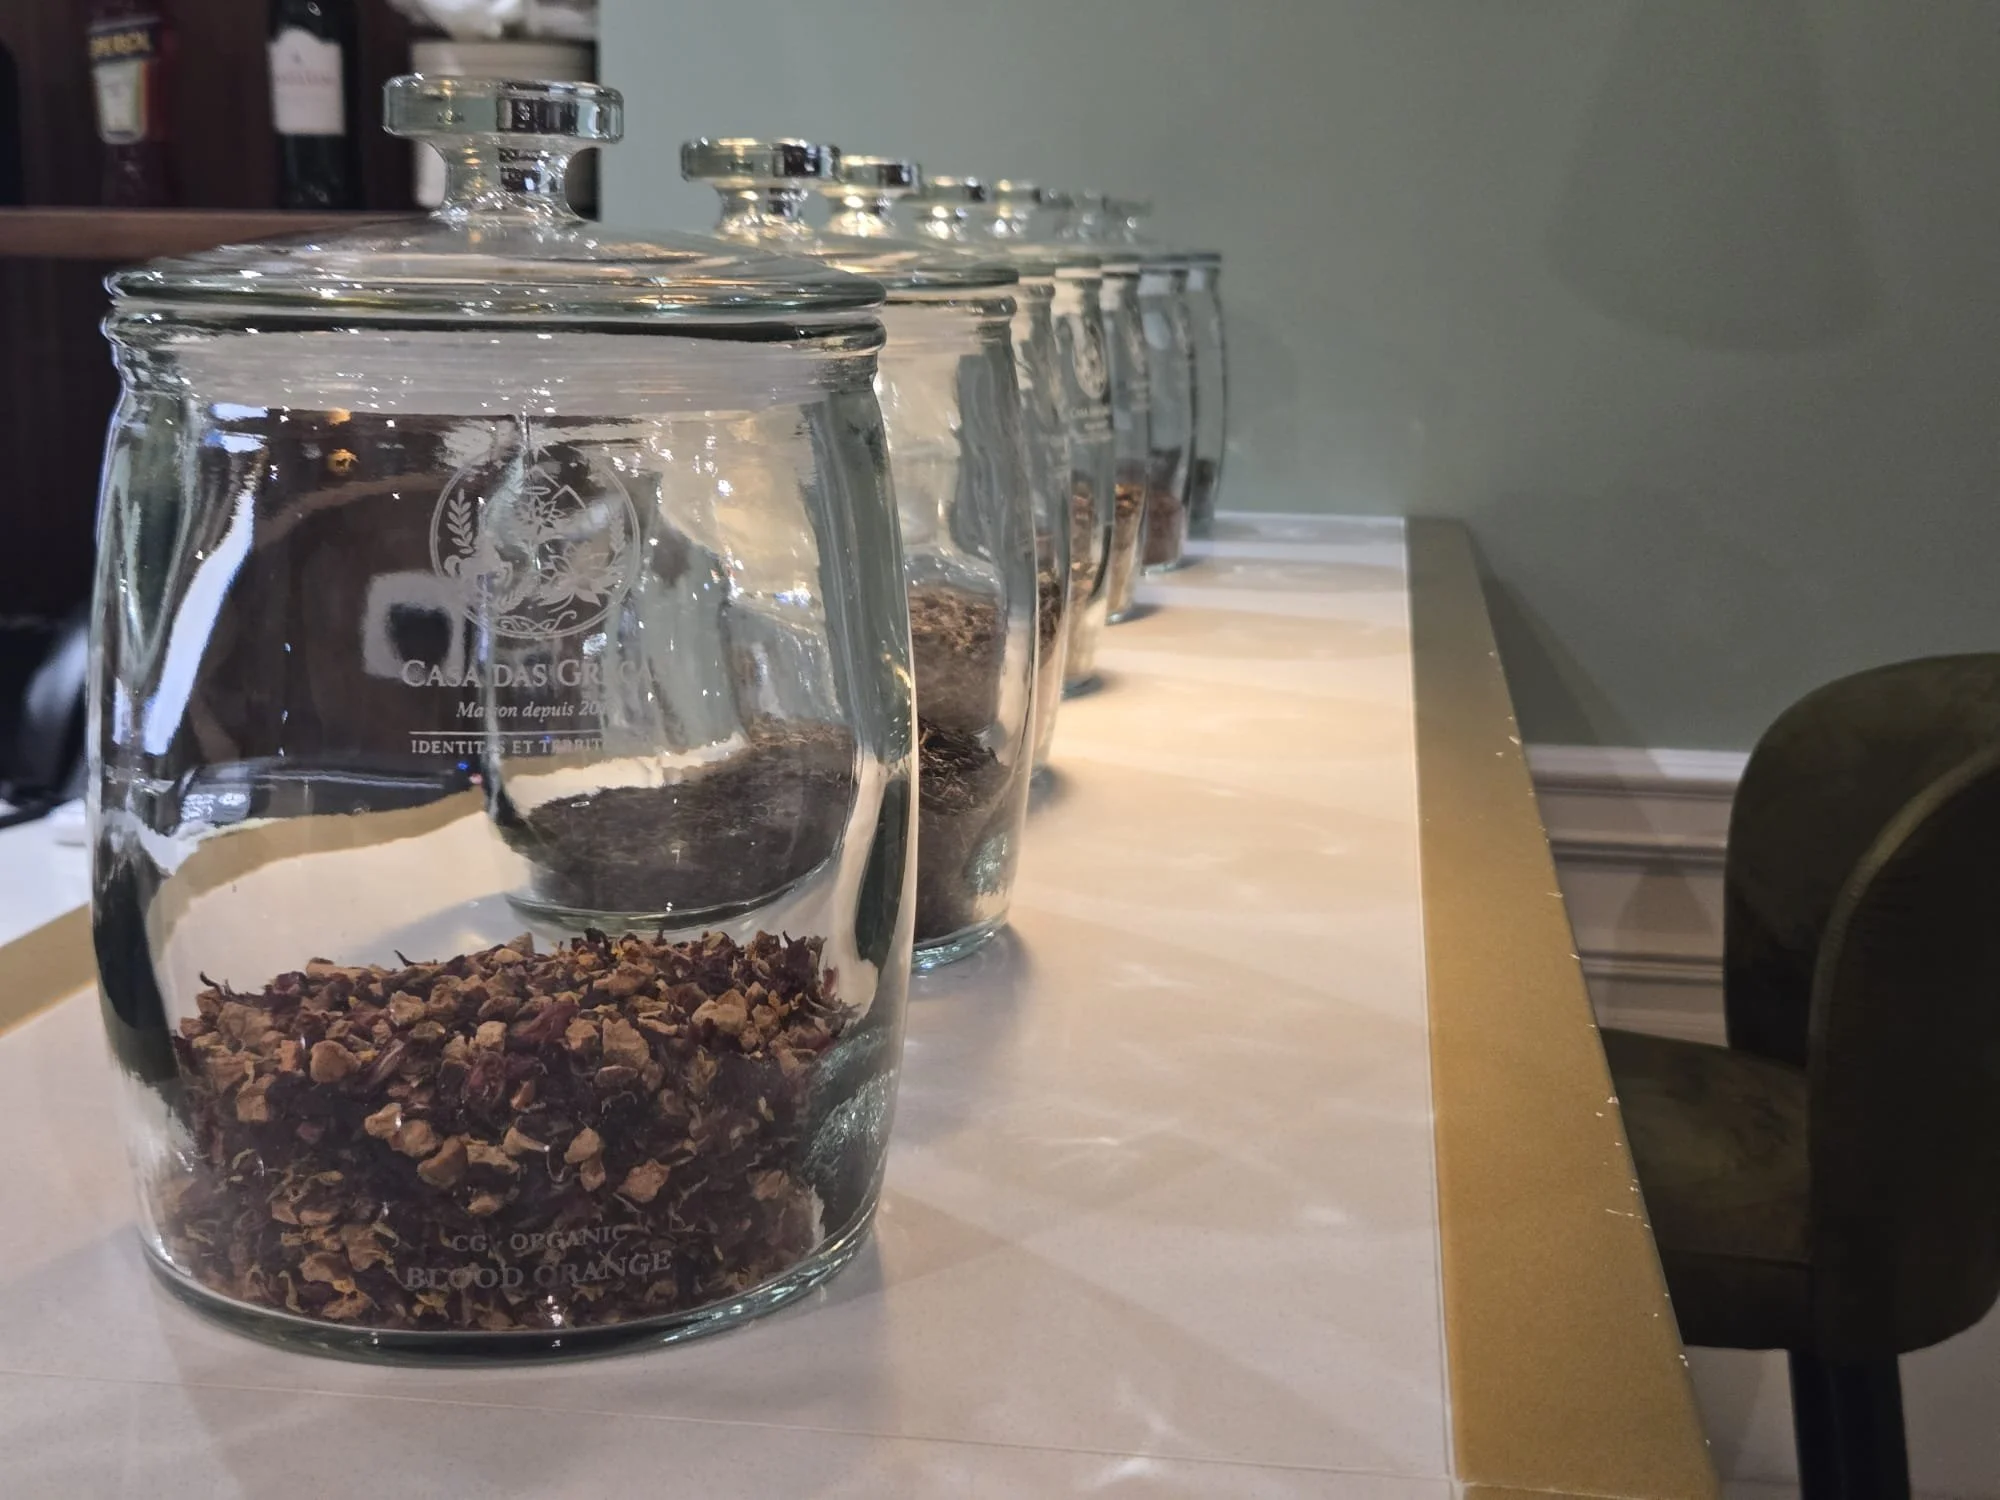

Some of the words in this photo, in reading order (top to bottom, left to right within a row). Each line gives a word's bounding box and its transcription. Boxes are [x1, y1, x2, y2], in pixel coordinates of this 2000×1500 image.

[493, 664, 547, 687] DAS
[456, 701, 518, 718] Maon
[521, 700, 575, 722] depuis
[512, 739, 534, 754] ET
[510, 1226, 628, 1251] ORGANIC
[406, 1266, 524, 1290] BLOOD
[534, 1249, 673, 1288] ORANGE
